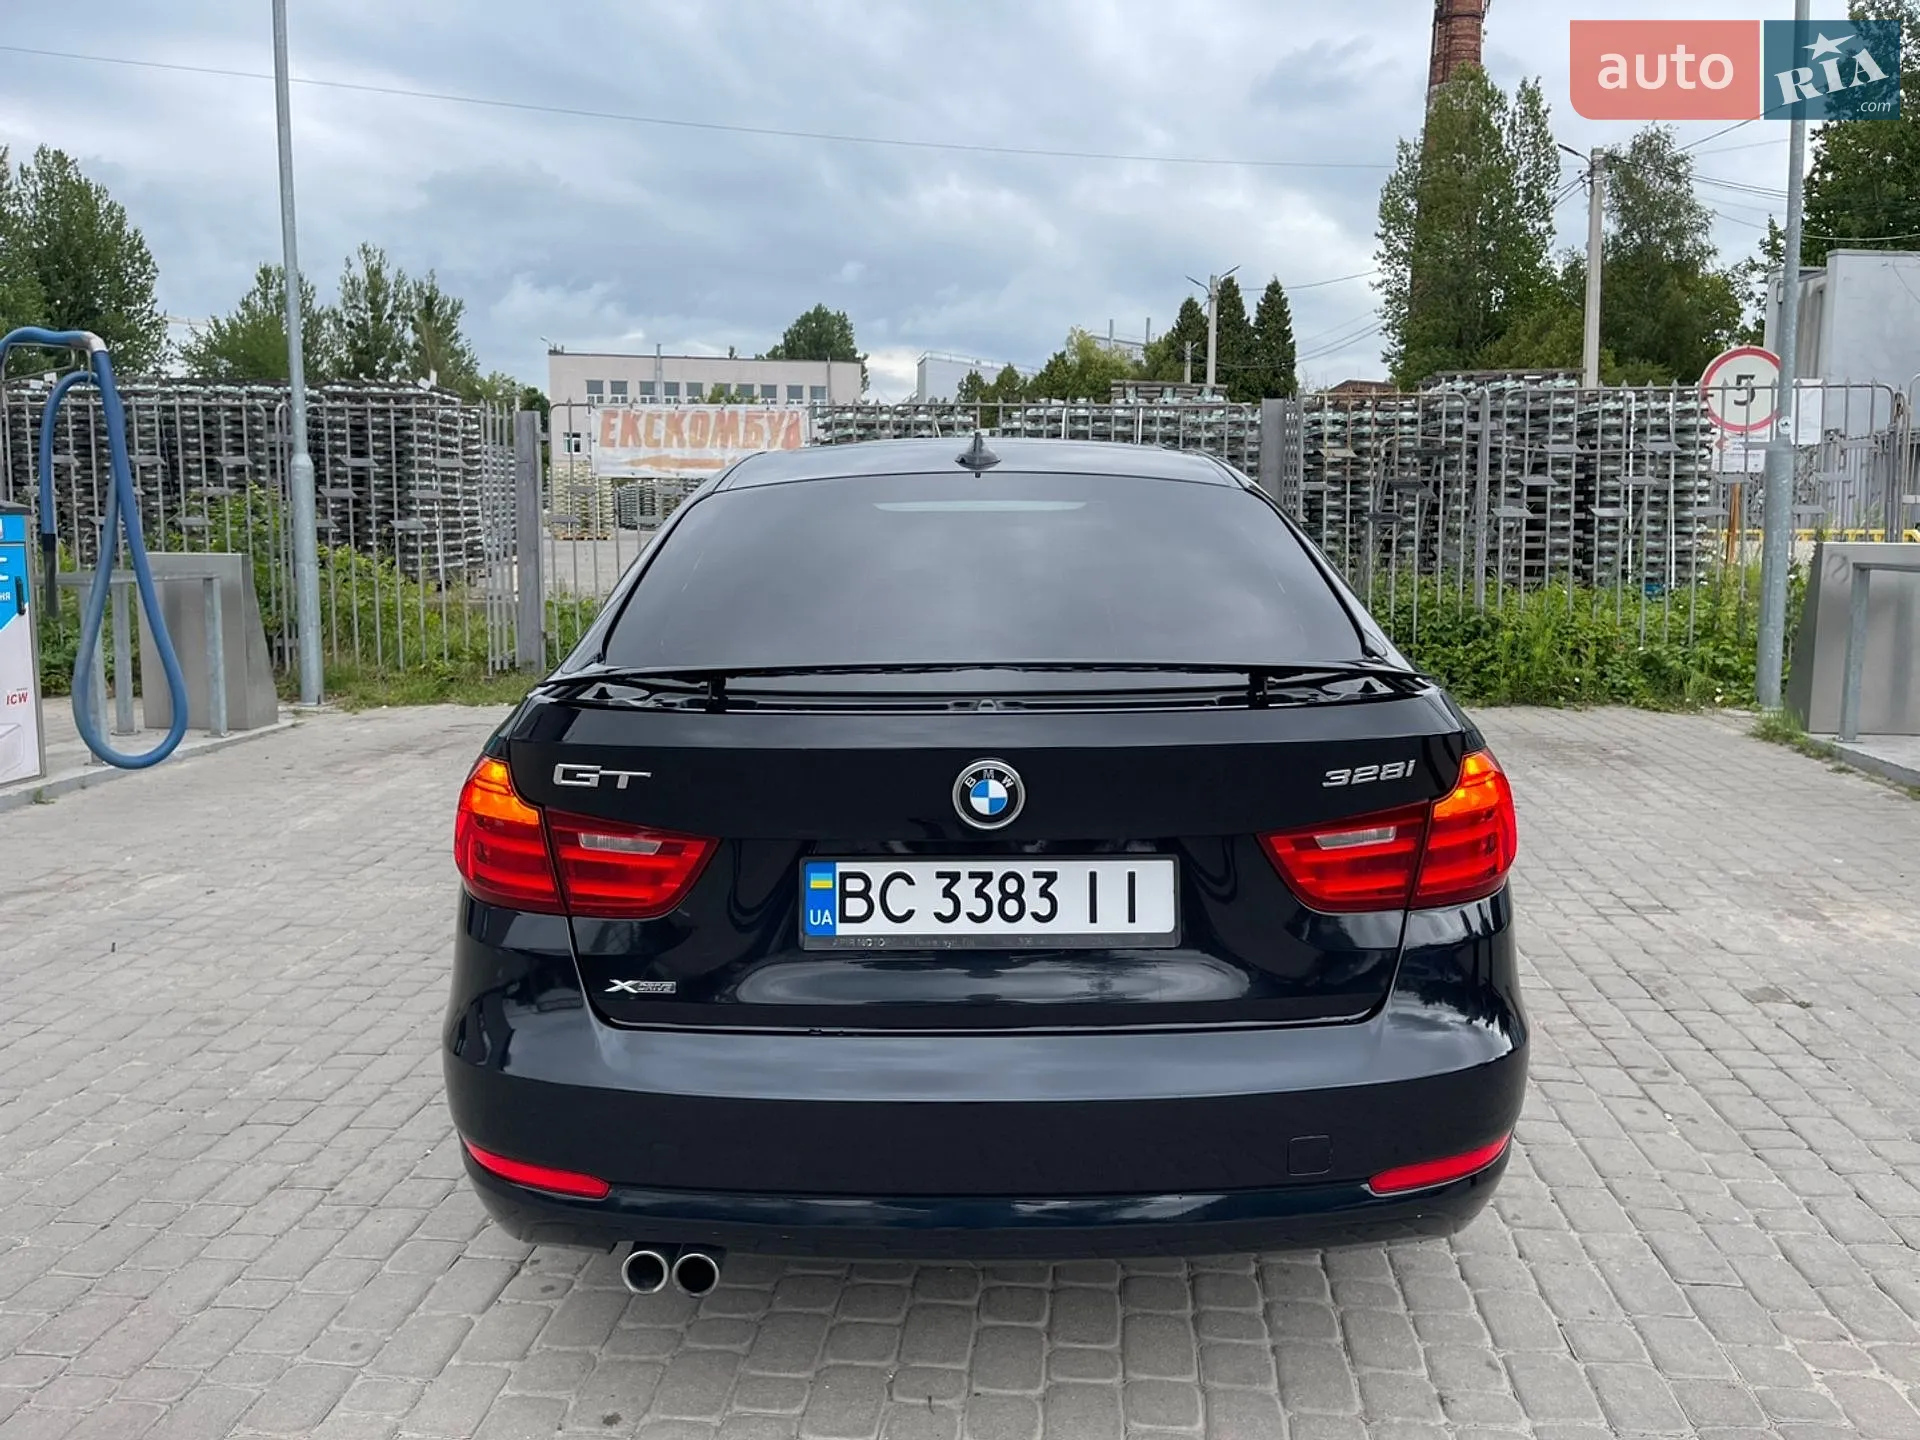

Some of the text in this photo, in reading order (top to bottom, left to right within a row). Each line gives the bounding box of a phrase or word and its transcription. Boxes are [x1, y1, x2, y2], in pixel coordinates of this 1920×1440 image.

[1733, 374, 1757, 406] 5
[6, 692, 28, 705] ICW
[553, 763, 652, 789] GT
[964, 769, 1015, 788] BMW
[1322, 759, 1416, 788] 328i
[838, 871, 916, 924] BC
[933, 871, 1059, 924] 3383
[809, 909, 833, 926] UA
